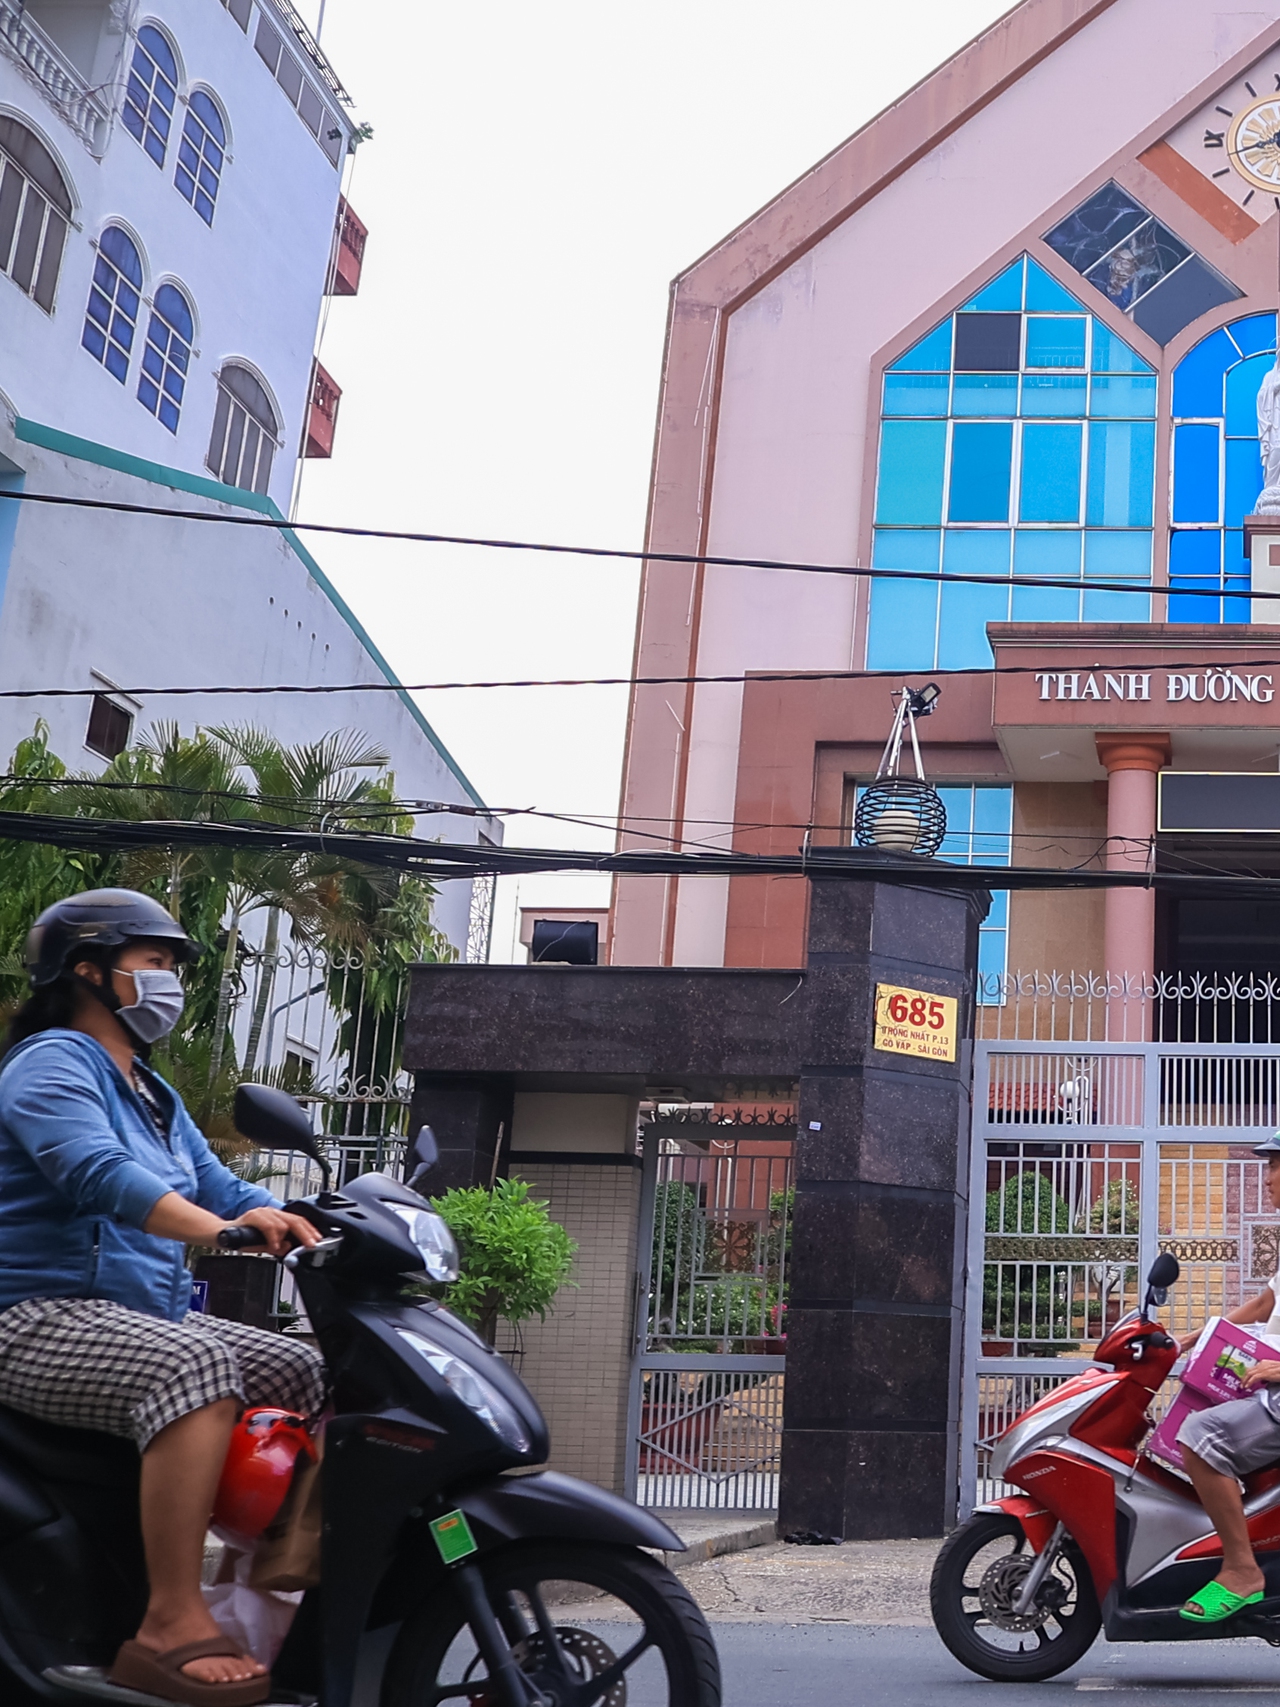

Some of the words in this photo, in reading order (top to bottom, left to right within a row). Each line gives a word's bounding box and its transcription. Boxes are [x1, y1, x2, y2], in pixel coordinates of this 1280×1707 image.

[1166, 667, 1275, 703] ĐƯỜNG
[890, 994, 945, 1030] 685
[1022, 1465, 1057, 1481] HONDA
